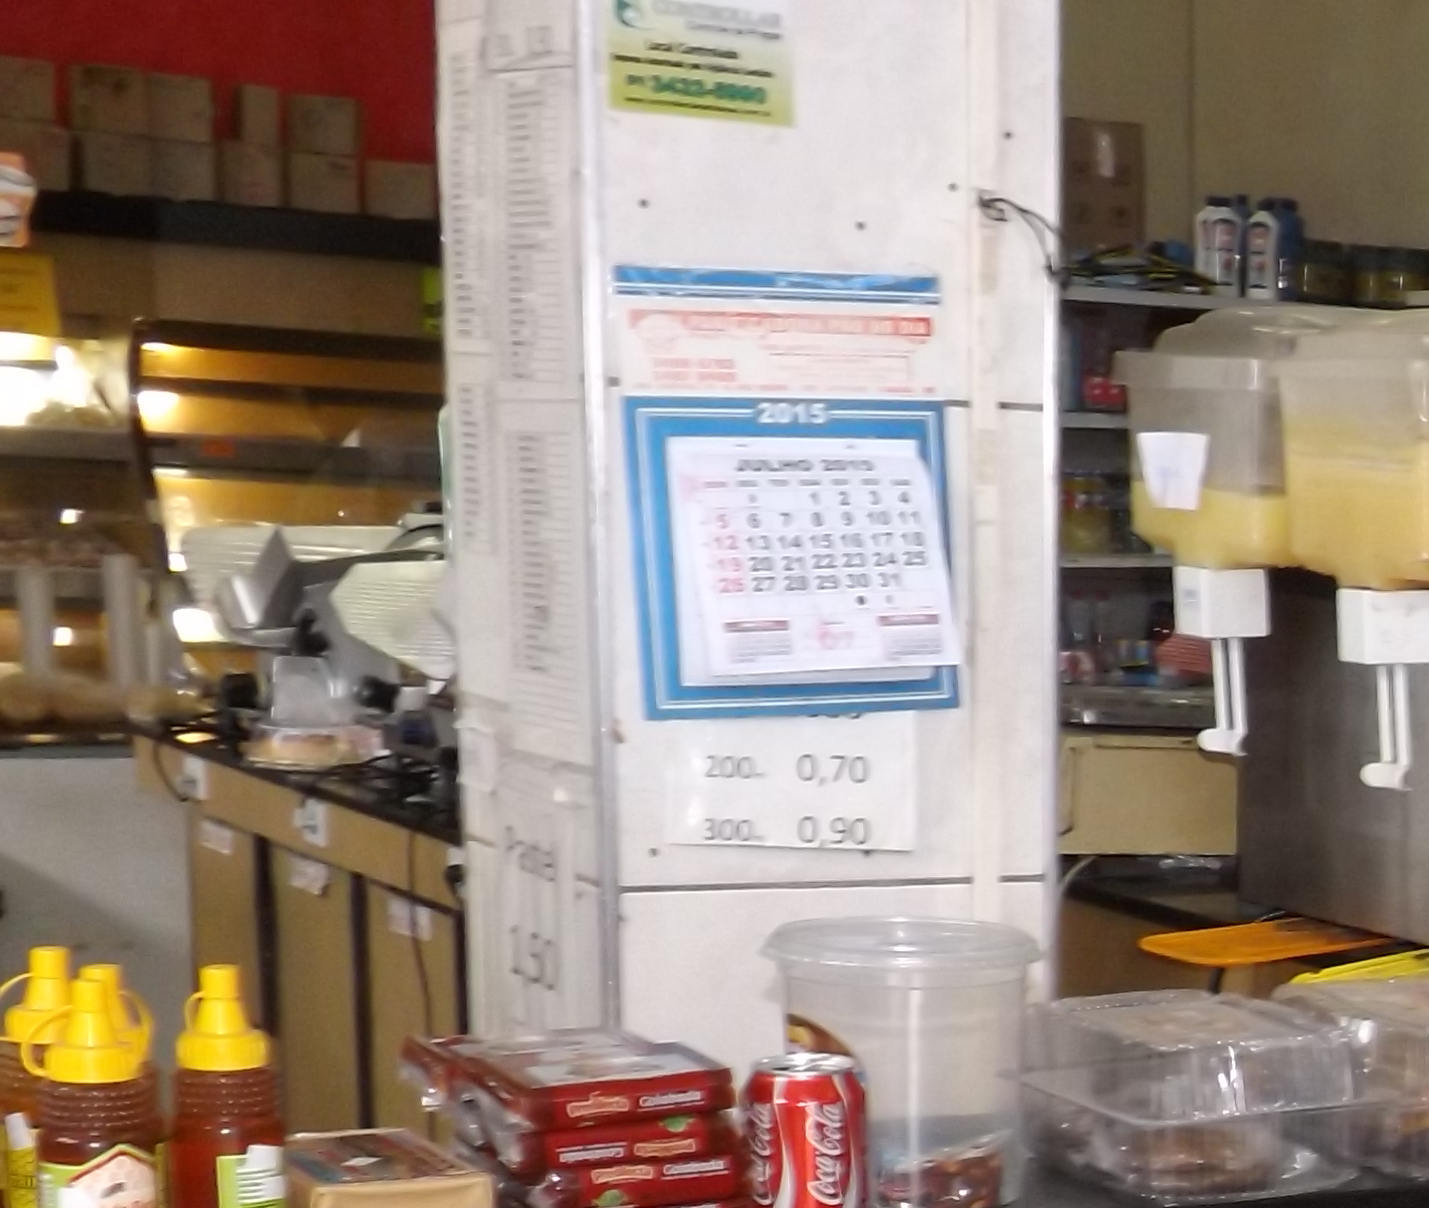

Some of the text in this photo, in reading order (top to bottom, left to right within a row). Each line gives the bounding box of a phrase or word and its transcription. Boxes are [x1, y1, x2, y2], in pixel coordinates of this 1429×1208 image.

[756, 402, 829, 424] 2015
[735, 458, 876, 472] JULHO 2015
[796, 753, 871, 786] 0,70
[797, 815, 871, 848] 0,90
